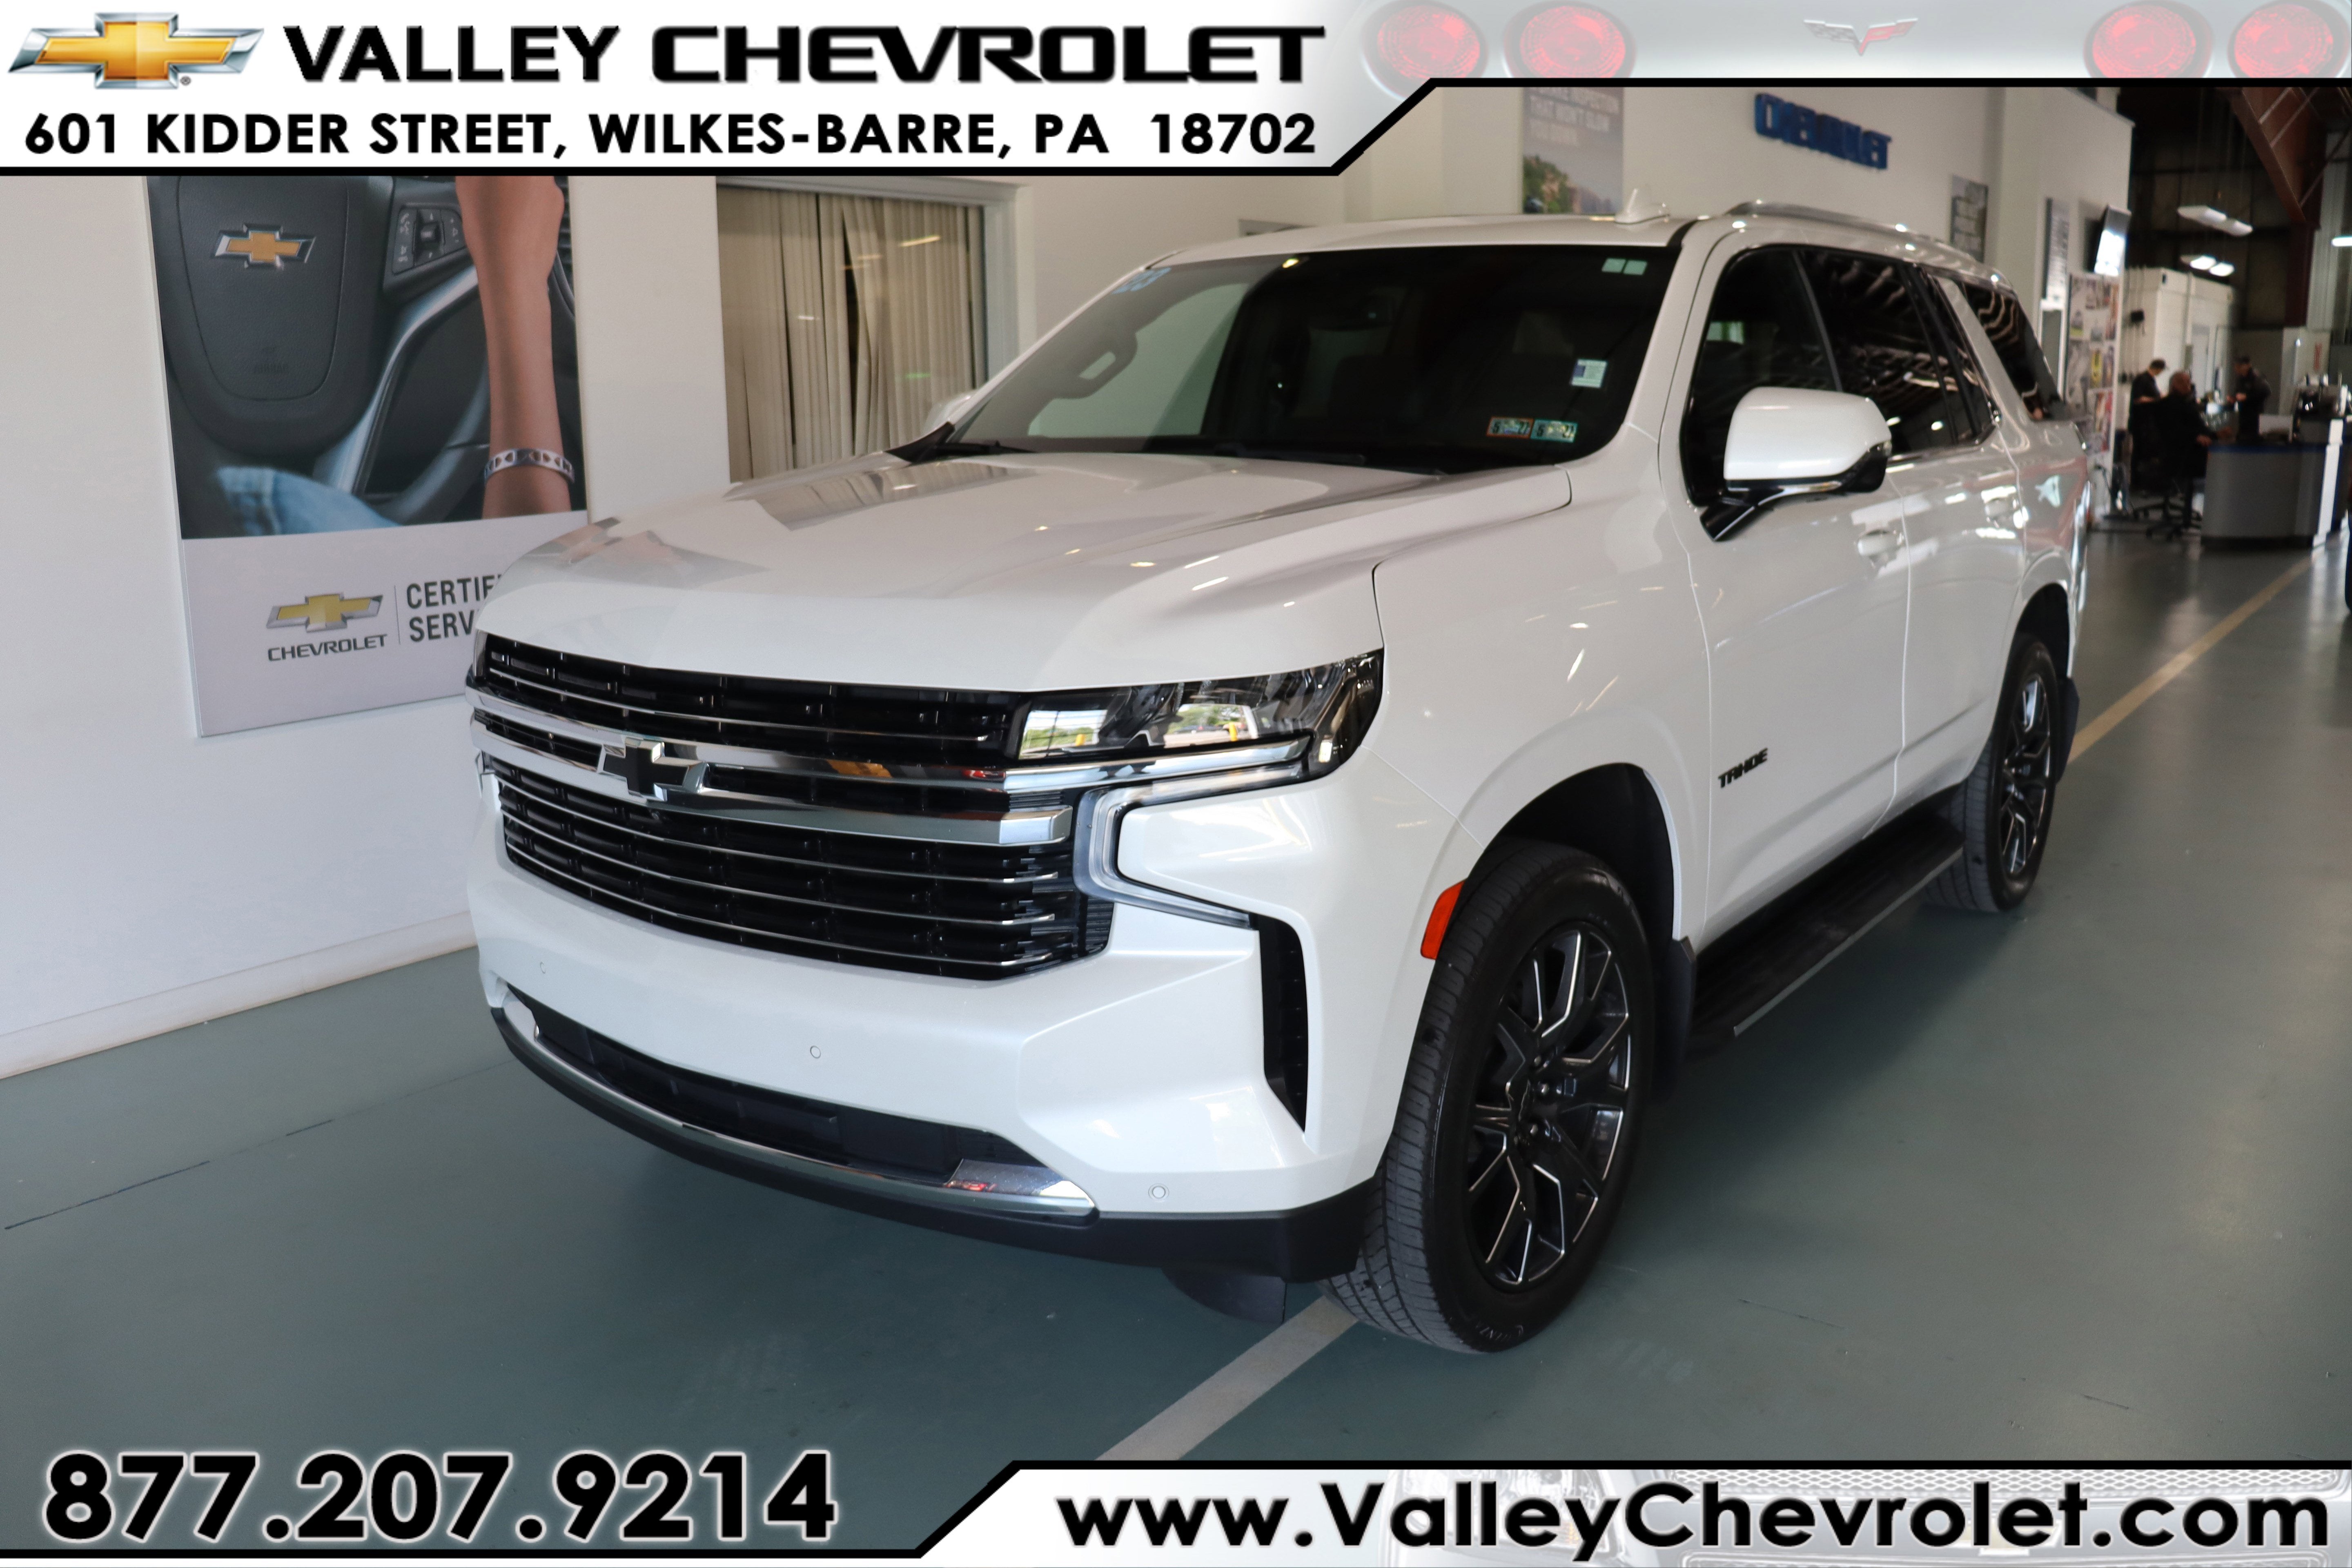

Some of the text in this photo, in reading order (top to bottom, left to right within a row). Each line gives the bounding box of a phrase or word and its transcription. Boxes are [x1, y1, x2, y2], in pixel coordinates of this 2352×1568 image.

[407, 574, 501, 609] CERTIF
[410, 610, 476, 642] SERV
[268, 635, 388, 662] CHEVROLET
[1718, 748, 1768, 788] TAHOE
